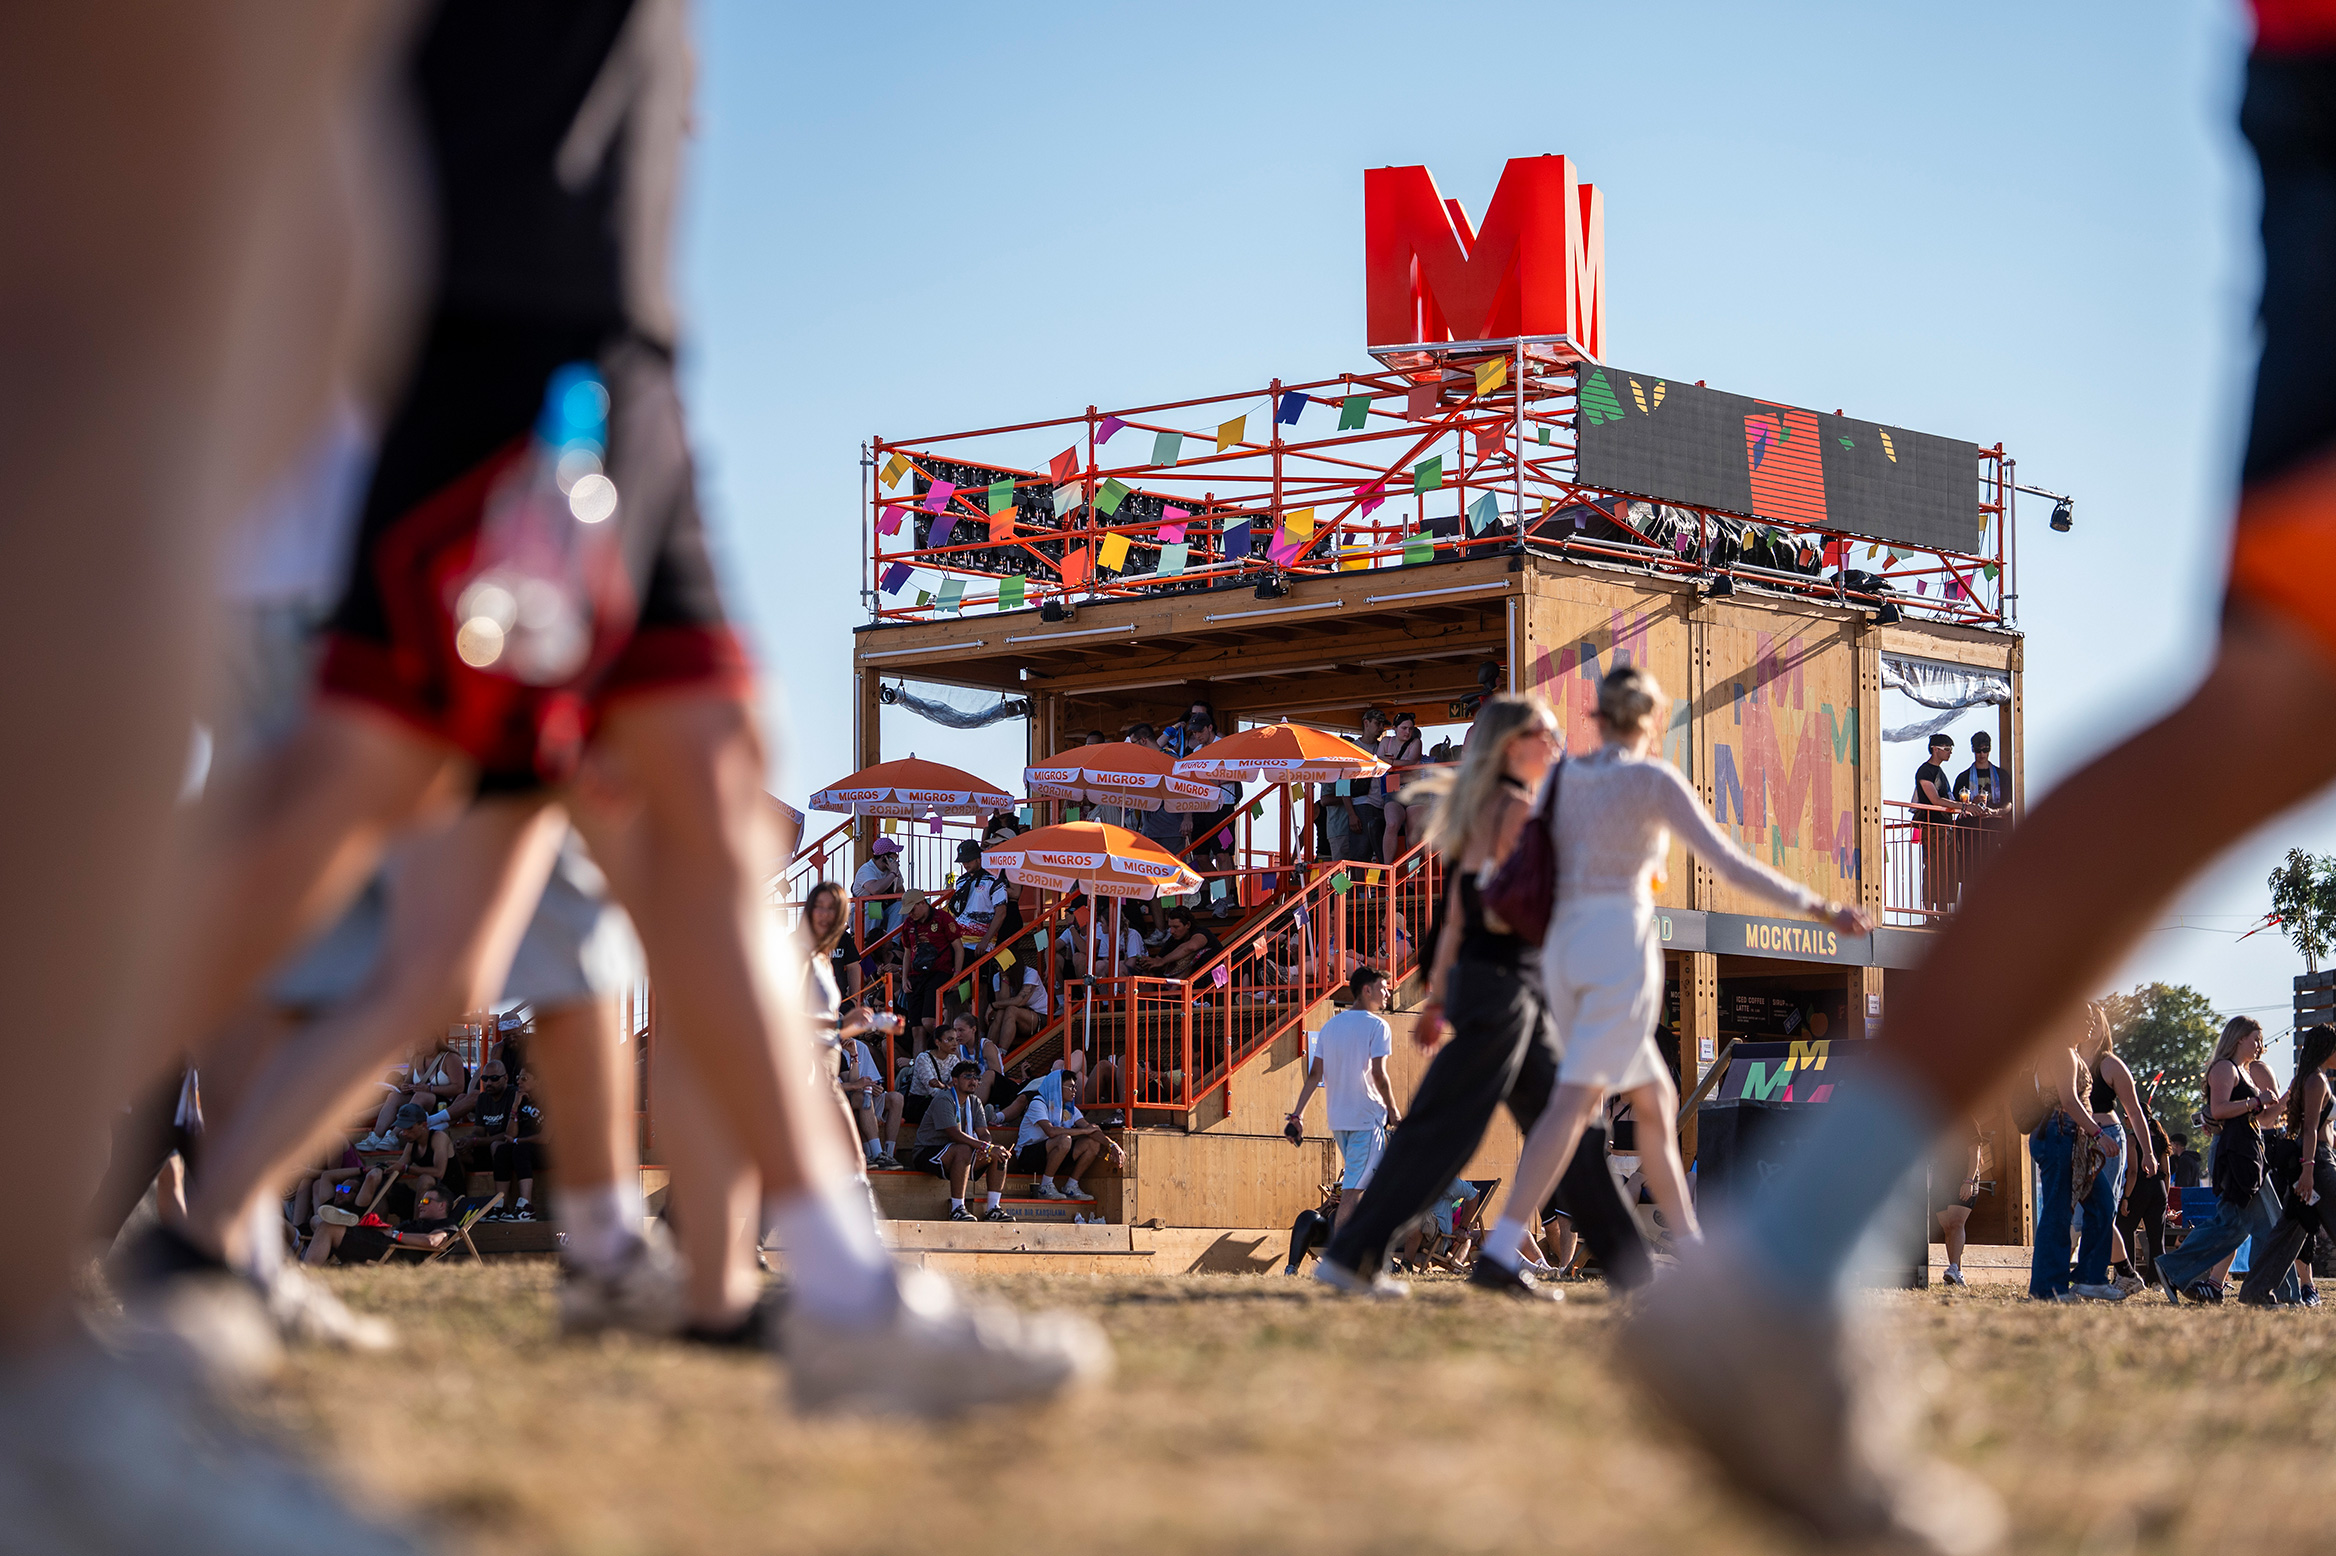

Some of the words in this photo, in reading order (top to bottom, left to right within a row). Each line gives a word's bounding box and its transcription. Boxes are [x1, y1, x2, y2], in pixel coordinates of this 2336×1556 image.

[1364, 154, 1566, 346] M
[1179, 761, 1210, 770] MIGROS
[1238, 759, 1289, 767] MIGROS
[1034, 770, 1069, 781] MIGROS
[1096, 773, 1146, 786] MIGROS
[1174, 781, 1210, 797] MIGROS
[838, 790, 879, 801] MIGROS
[909, 792, 956, 803] MIGROS
[981, 795, 1009, 807] MIGROS
[989, 855, 1017, 866] MIGROS
[1042, 854, 1092, 866] MIGROS
[1123, 861, 1170, 877] MIGROS
[1651, 914, 1673, 941] OD
[1745, 923, 1837, 956] MOCKTAILS
[1735, 996, 1747, 1004] ICED
[1748, 996, 1765, 1005] COFFEE
[1735, 1004, 1750, 1012] LATTE
